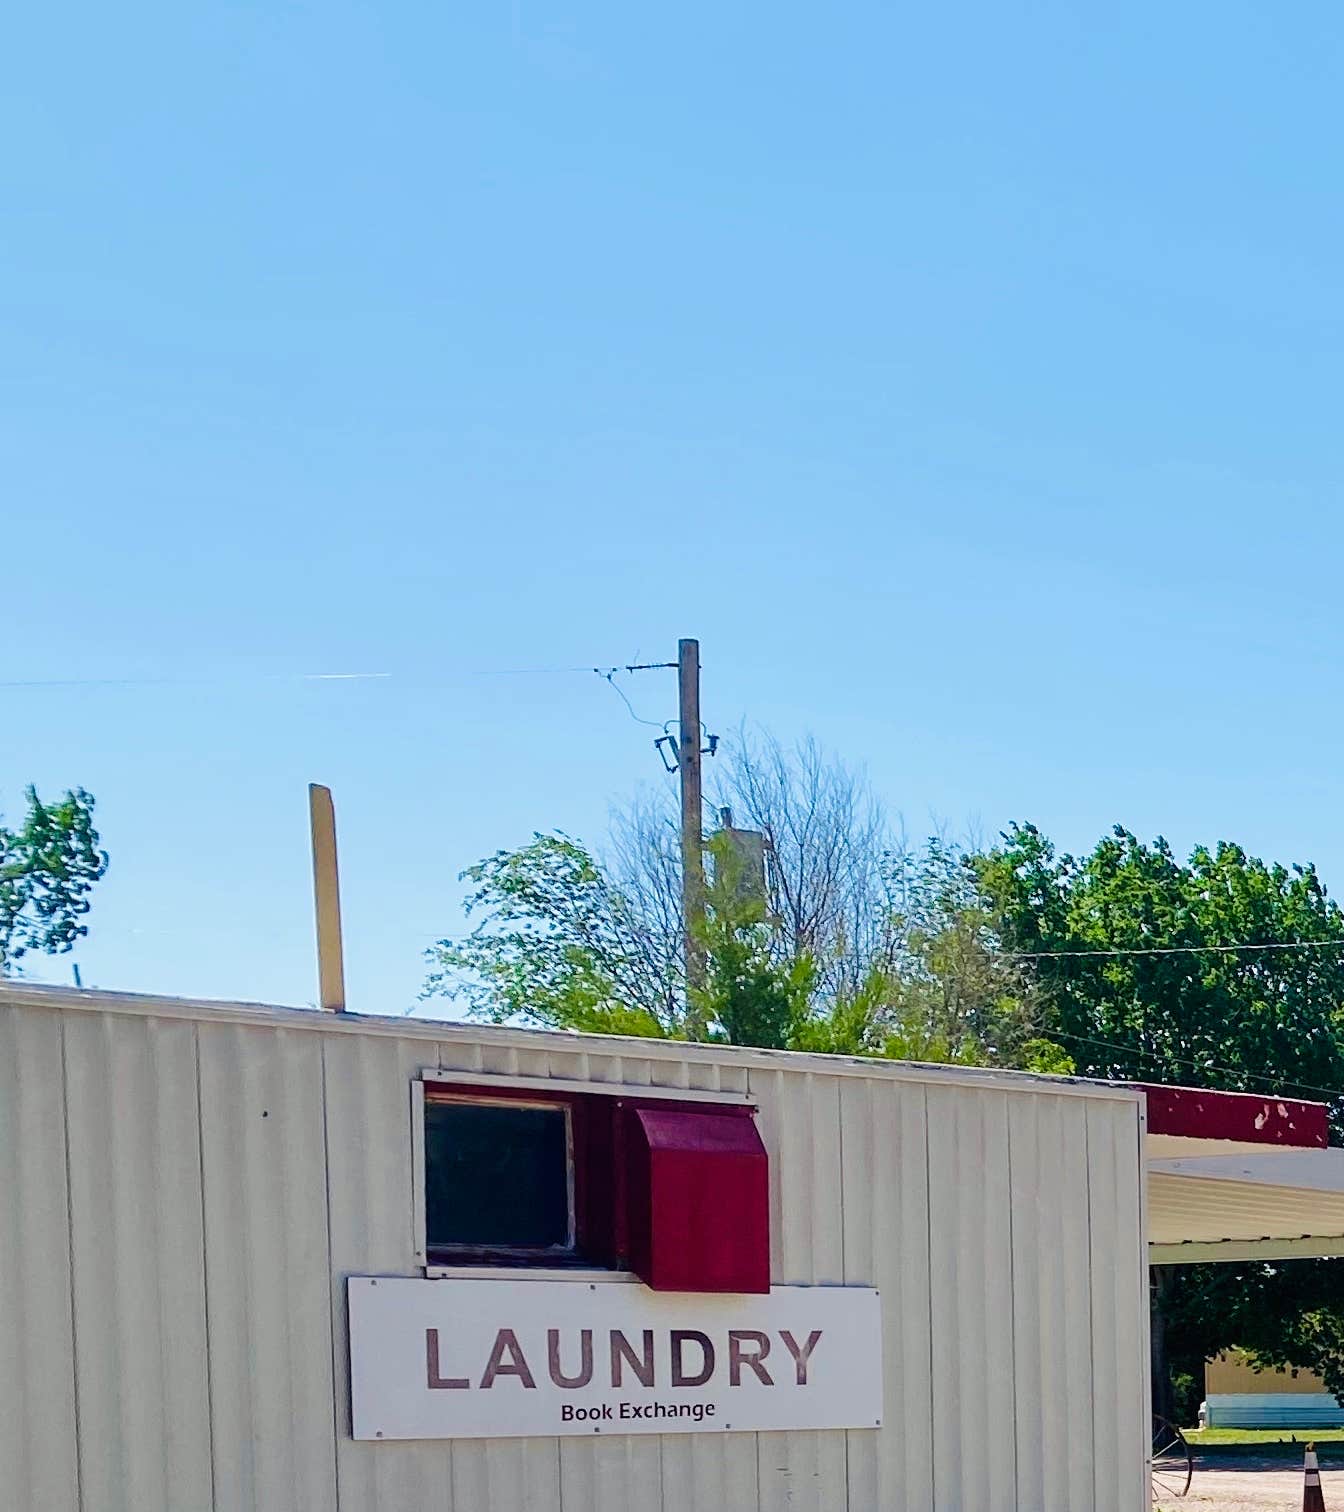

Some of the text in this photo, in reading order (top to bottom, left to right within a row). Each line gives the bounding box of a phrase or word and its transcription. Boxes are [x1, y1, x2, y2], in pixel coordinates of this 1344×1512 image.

[426, 1328, 823, 1389] LAUNDRY
[561, 1401, 716, 1421] Book Exchange
